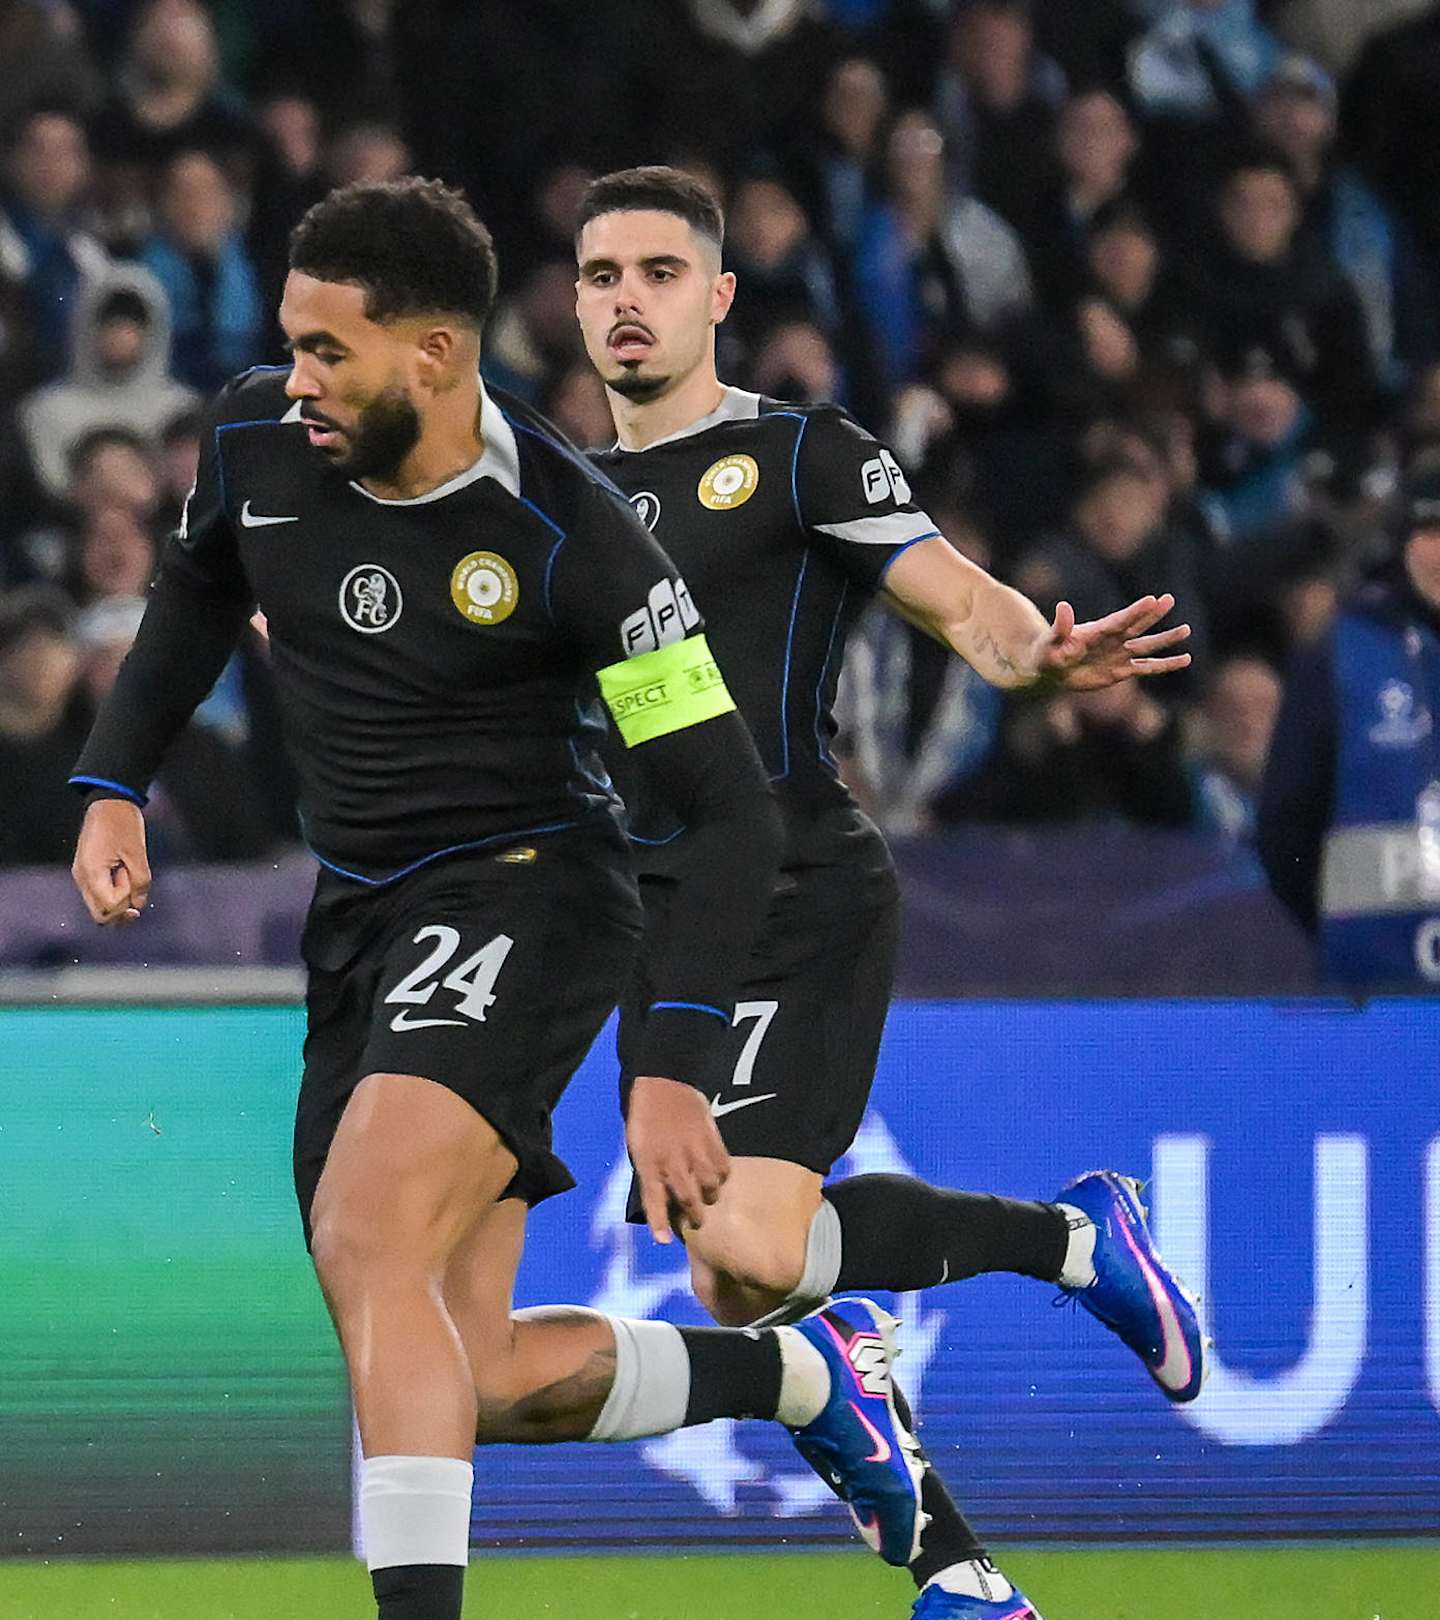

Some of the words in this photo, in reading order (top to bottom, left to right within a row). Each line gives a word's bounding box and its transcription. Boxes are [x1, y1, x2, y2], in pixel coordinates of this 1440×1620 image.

[612, 684, 666, 715] SPECT
[384, 924, 514, 1022] 24
[731, 1001, 779, 1085] 7
[1152, 1130, 1440, 1446] U
